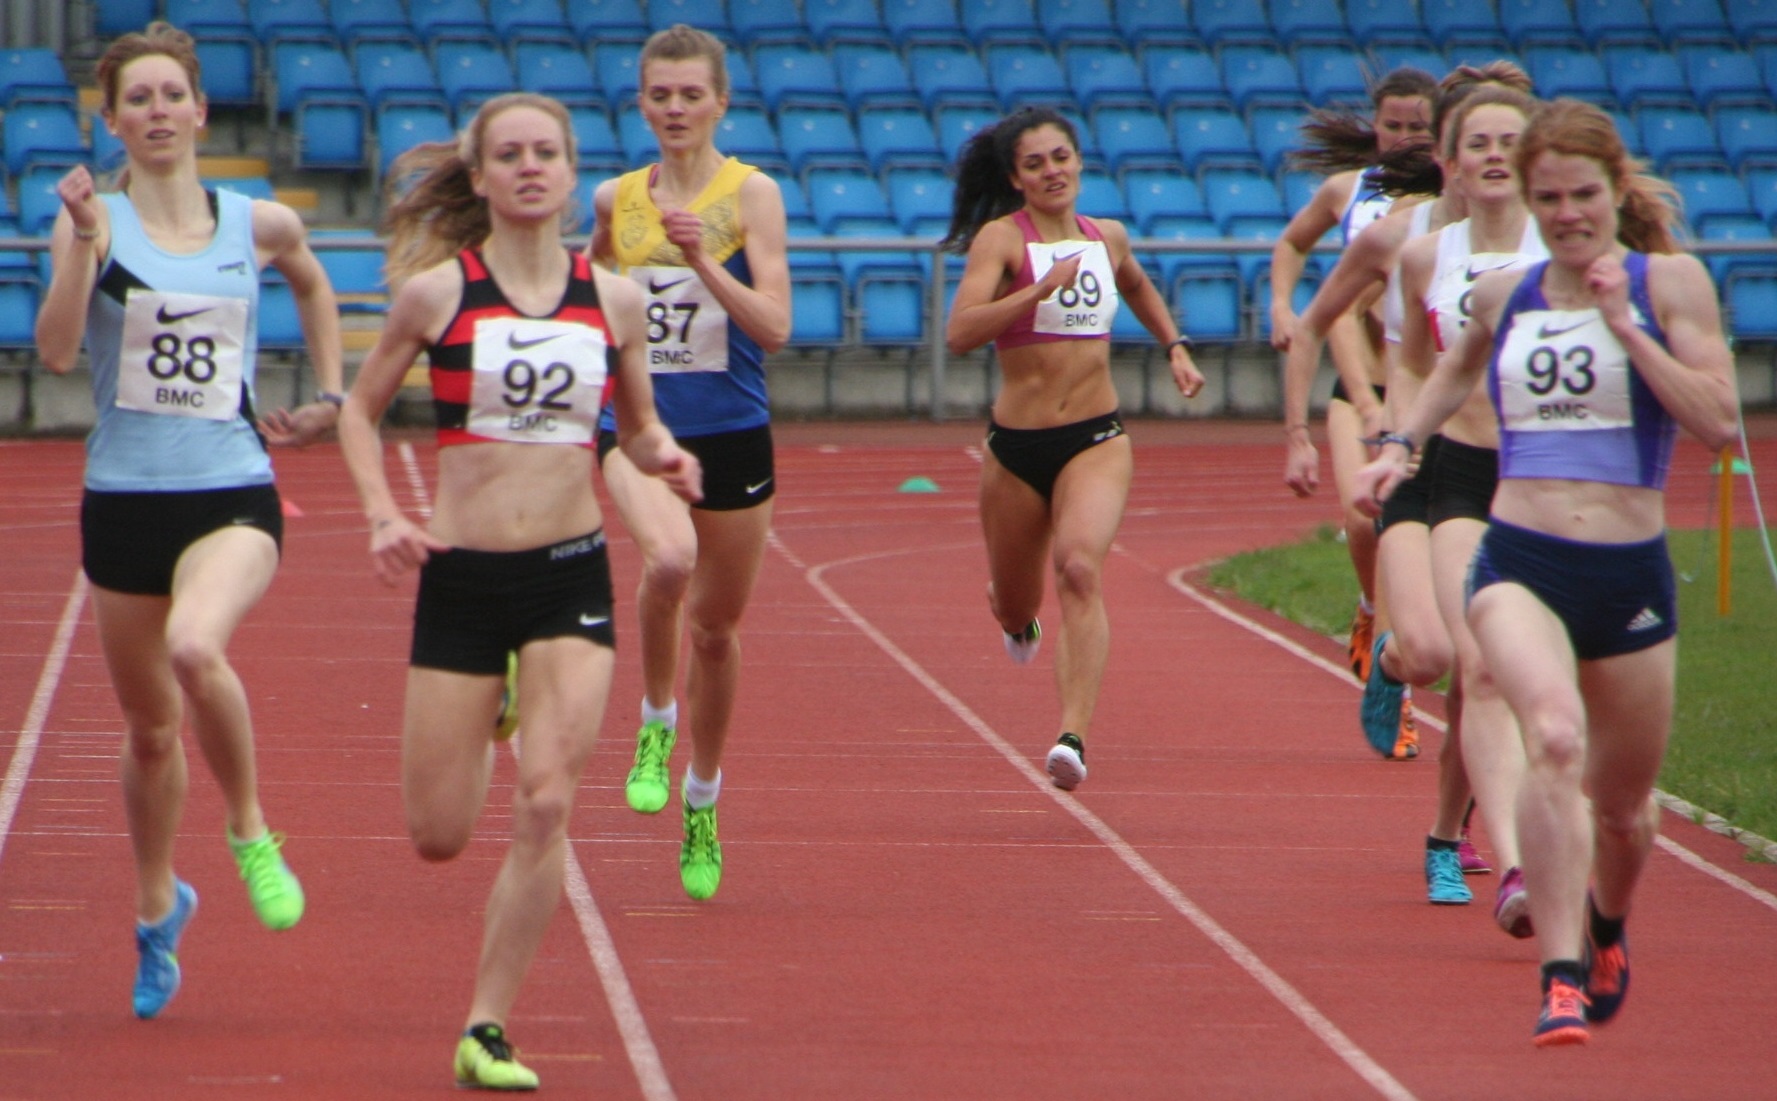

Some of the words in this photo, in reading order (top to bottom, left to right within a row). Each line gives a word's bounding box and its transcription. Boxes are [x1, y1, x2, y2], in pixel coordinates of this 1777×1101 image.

[1059, 270, 1101, 308] 89
[647, 301, 699, 344] 87
[1065, 313, 1099, 327] BMC
[147, 332, 217, 383] 88
[651, 349, 694, 364] BMC
[1526, 345, 1596, 396] 93
[502, 359, 575, 410] 92
[155, 388, 206, 407] BMC
[1538, 403, 1588, 420] BMC
[508, 414, 559, 432] BMC
[551, 540, 592, 560] NIKE
